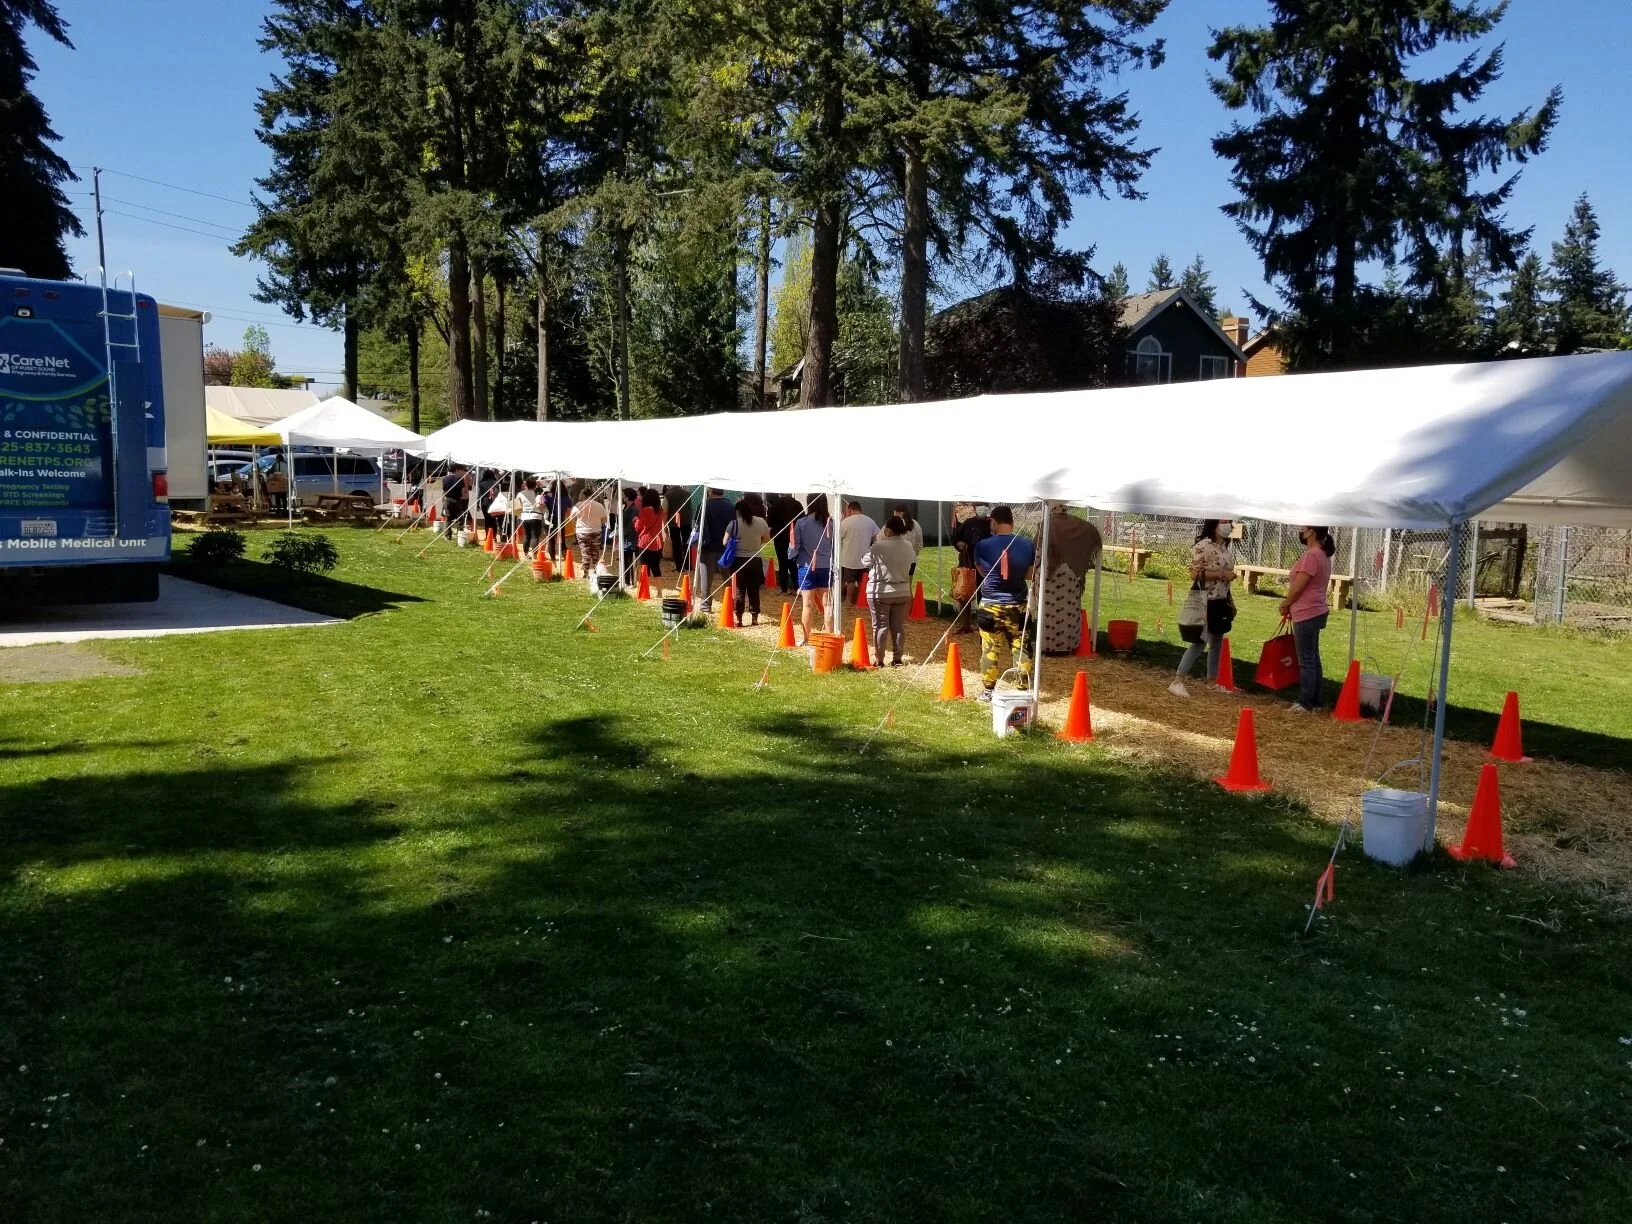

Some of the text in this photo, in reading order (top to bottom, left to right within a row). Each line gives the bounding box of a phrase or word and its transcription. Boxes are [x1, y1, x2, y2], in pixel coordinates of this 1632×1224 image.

[11, 354, 70, 368] Care Net
[4, 430, 98, 441] & CONFIDENTIAL
[37, 469, 86, 478] Welcome
[22, 491, 65, 499] Screenings
[8, 539, 56, 548] Mobile
[62, 538, 115, 548] Medical
[119, 539, 147, 547] Unit
